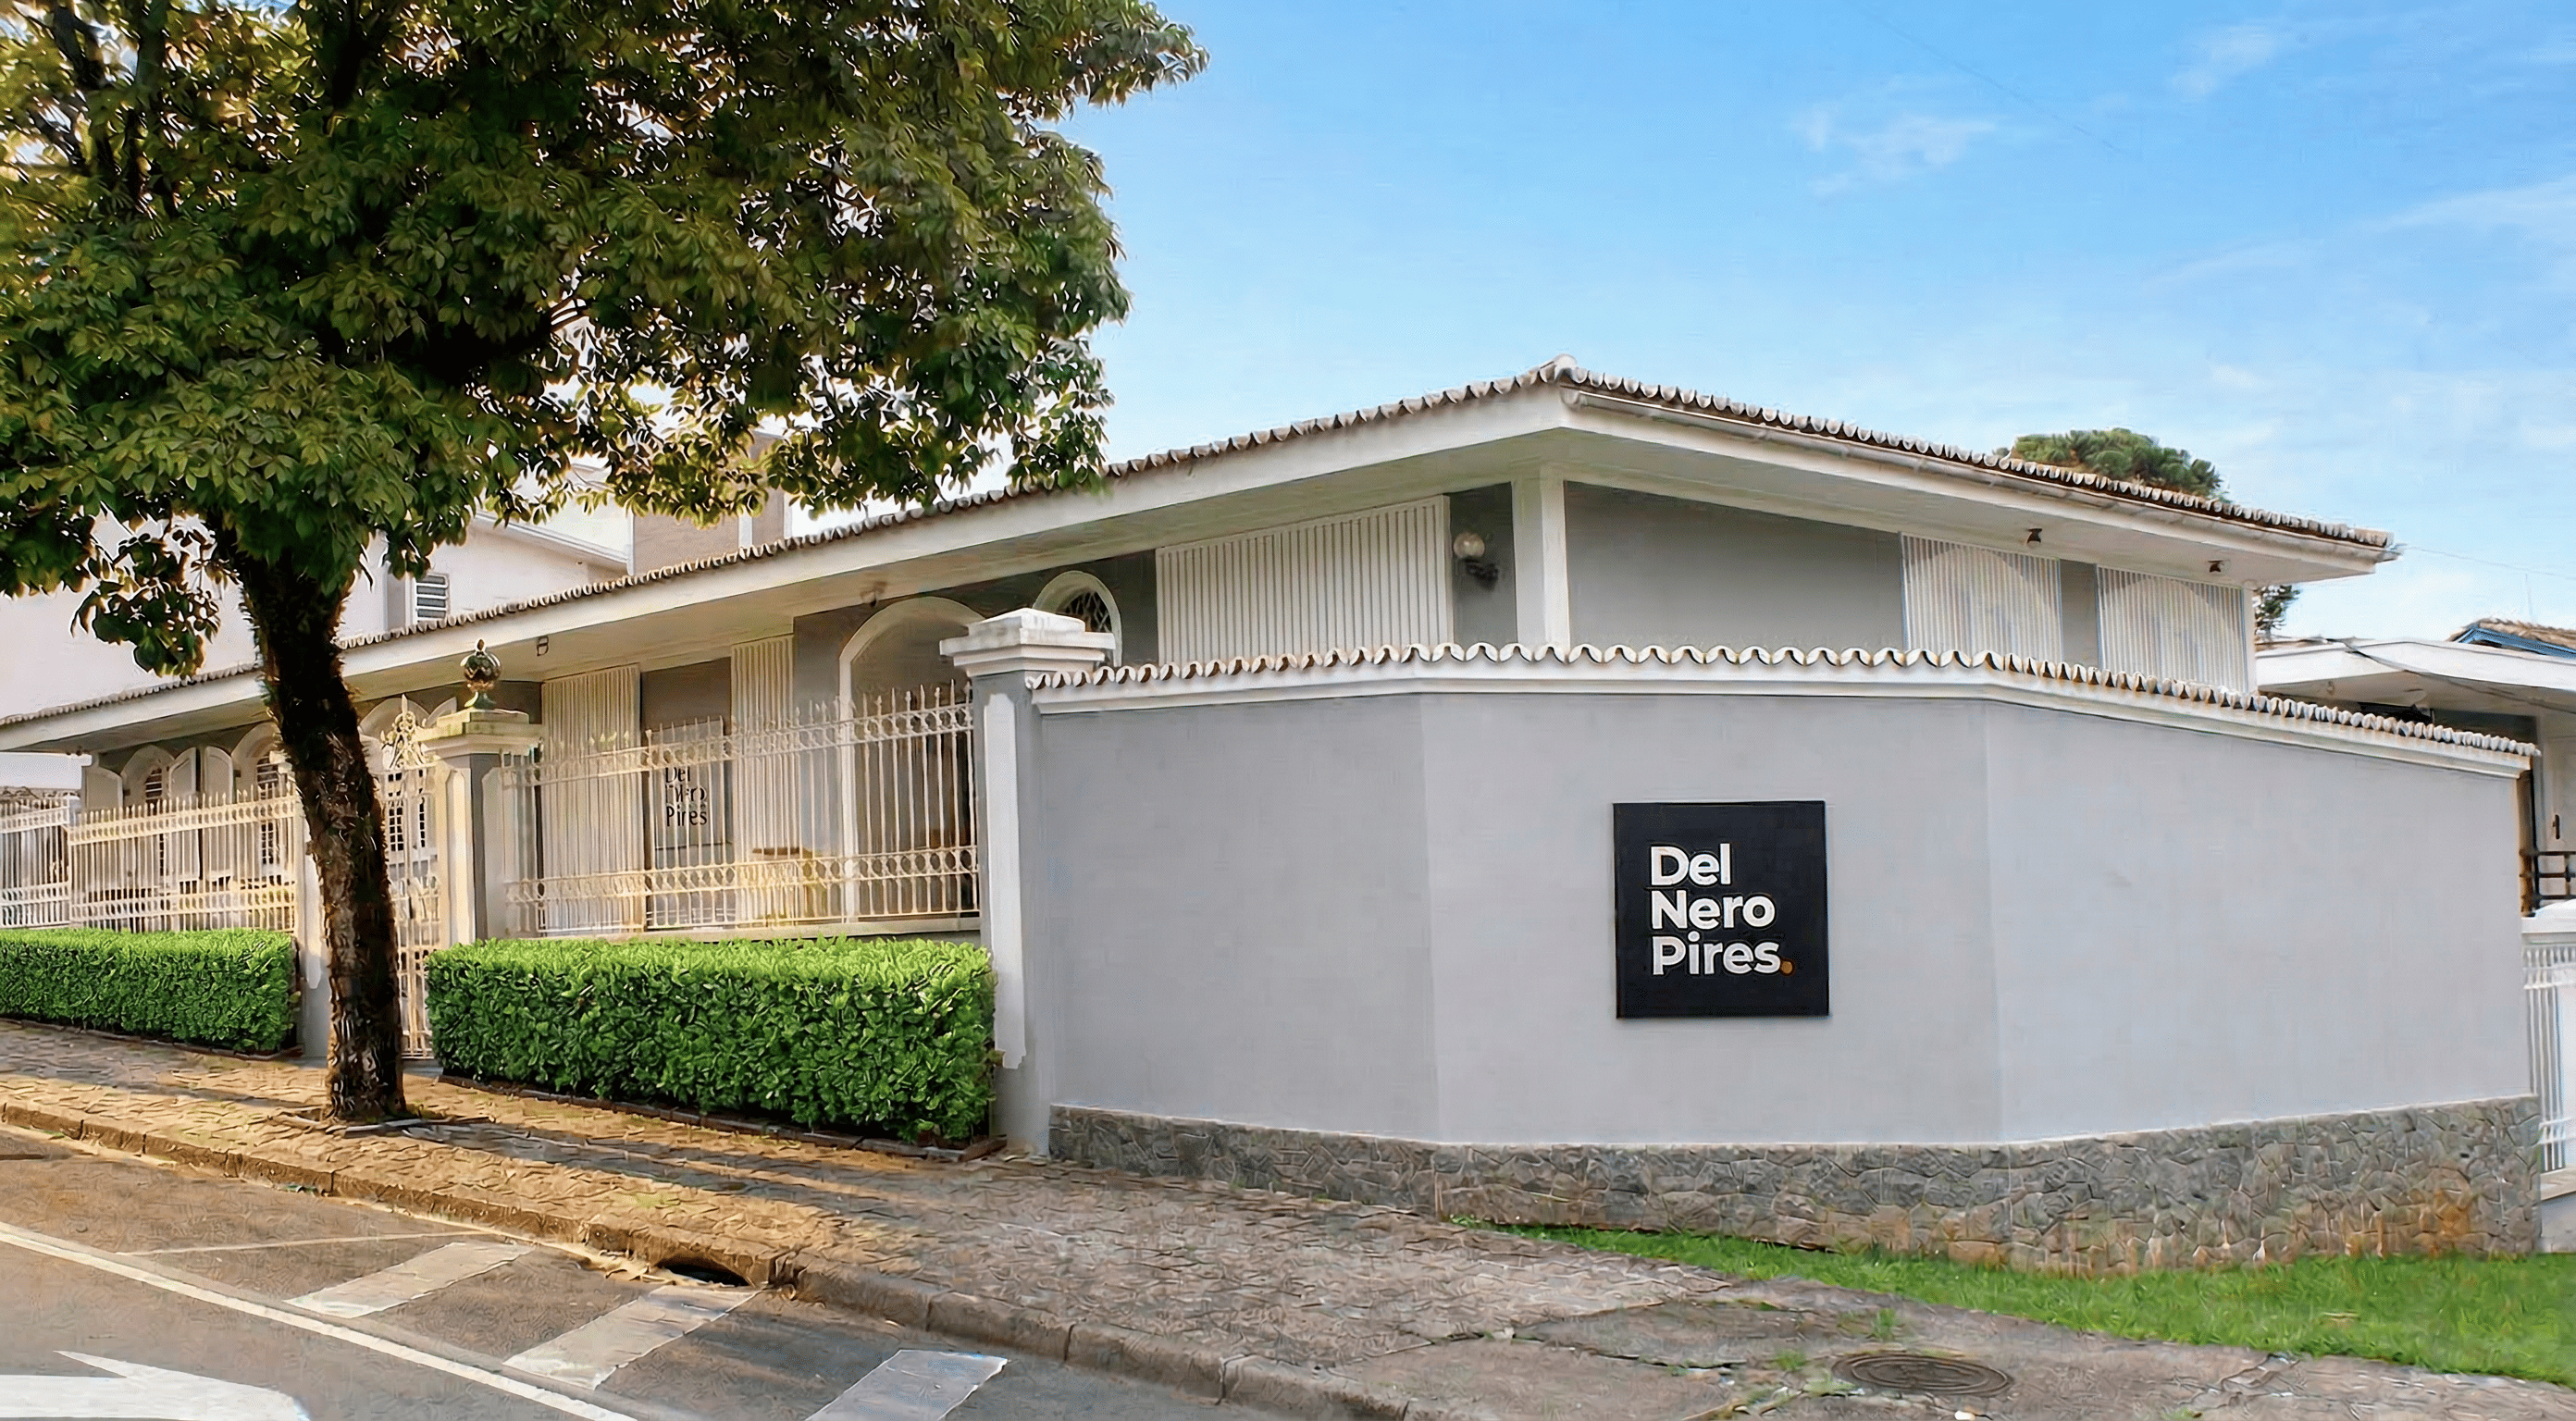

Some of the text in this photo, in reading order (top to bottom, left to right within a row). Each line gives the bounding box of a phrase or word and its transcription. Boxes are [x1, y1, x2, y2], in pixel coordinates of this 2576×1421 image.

[665, 766, 691, 784] Del
[666, 804, 708, 827] Pires
[1651, 843, 1731, 886] Del
[1652, 890, 1776, 930] Nero
[1653, 931, 1793, 975] Pires.
